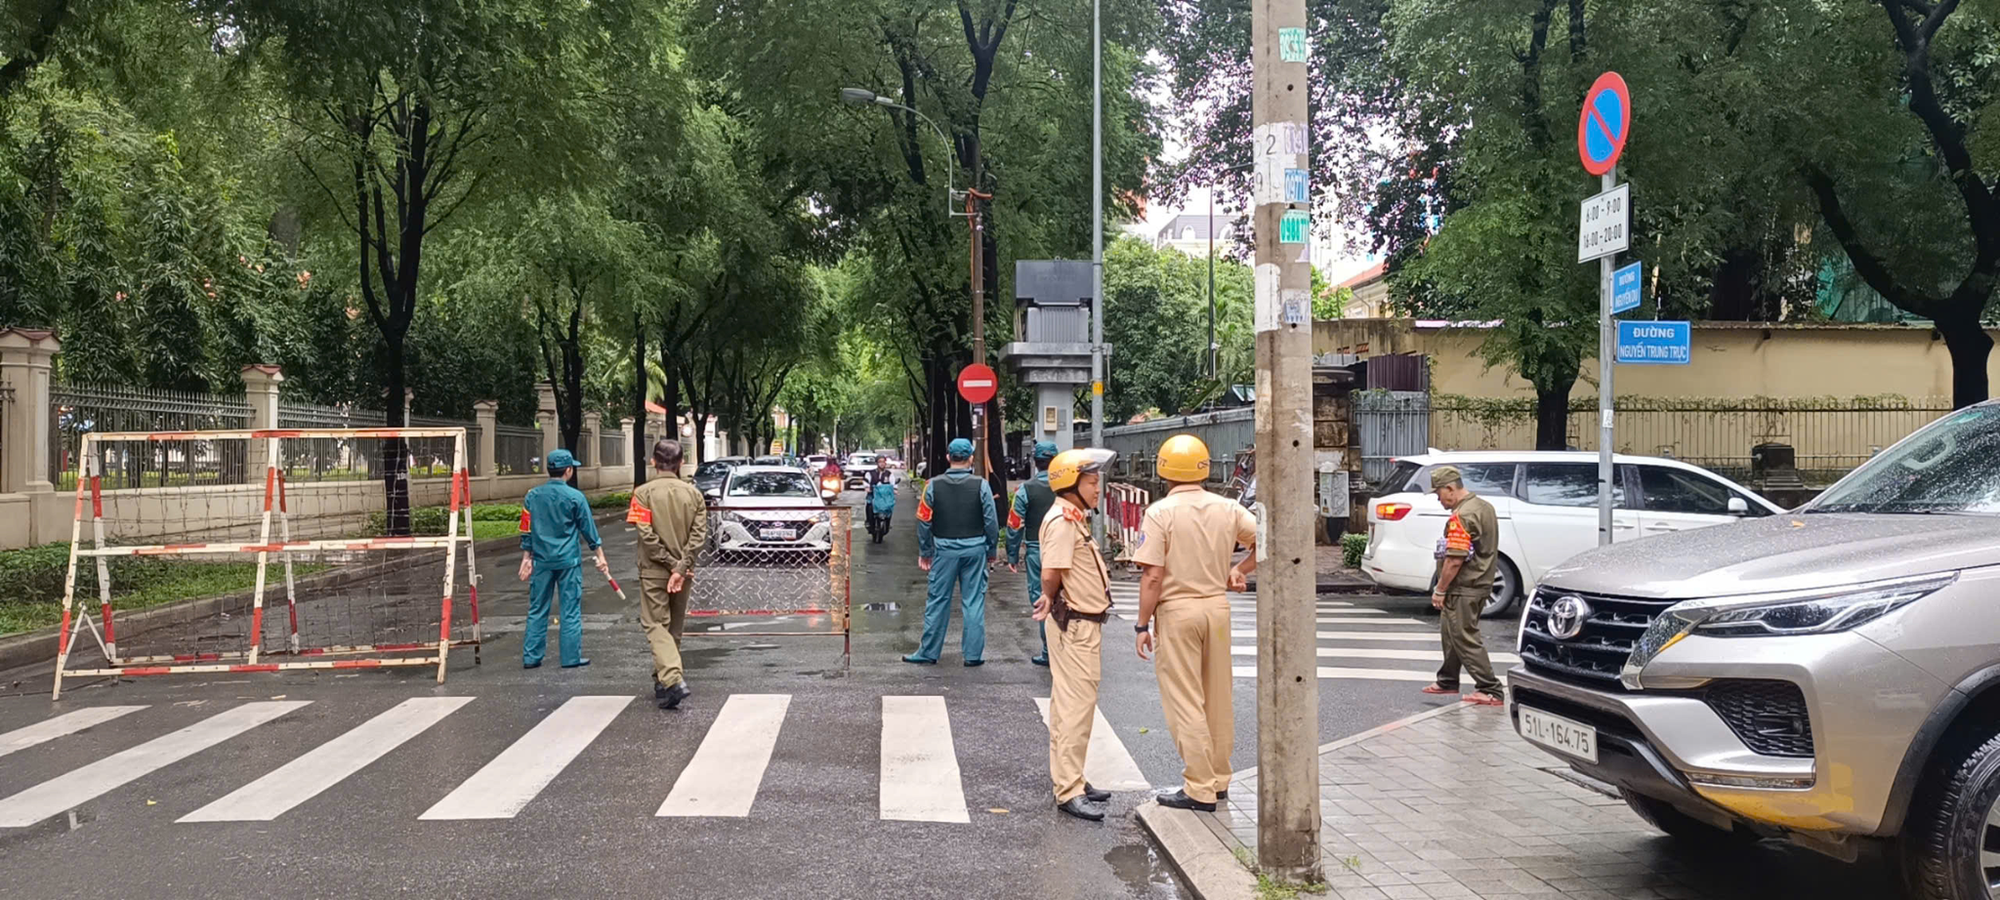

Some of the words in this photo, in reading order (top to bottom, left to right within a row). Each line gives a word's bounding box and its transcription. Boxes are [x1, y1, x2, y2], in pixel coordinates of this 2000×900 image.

[1633, 325, 1675, 338] ĐƯỜNG
[1620, 341, 1646, 358] NGUYỄN
[1647, 345, 1669, 358] TRUNG
[1669, 345, 1687, 360] TRỰC
[1525, 713, 1589, 753] 51L-164.75
